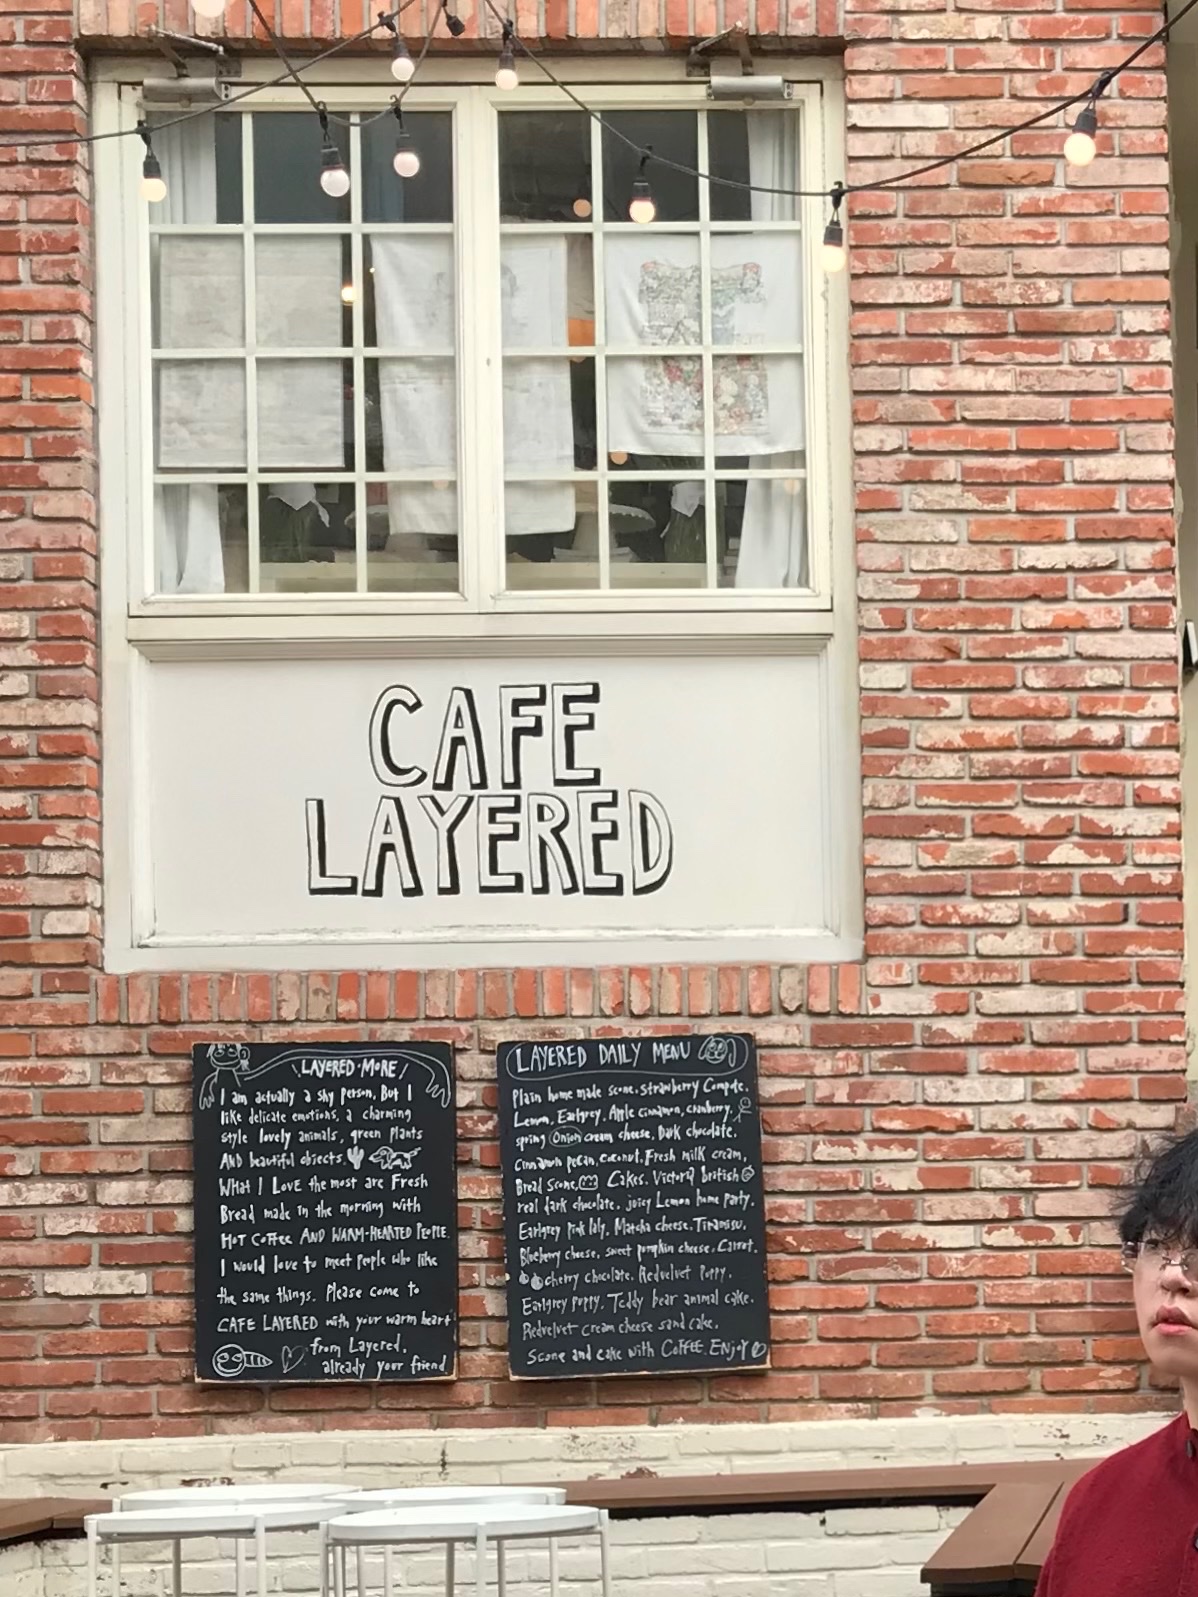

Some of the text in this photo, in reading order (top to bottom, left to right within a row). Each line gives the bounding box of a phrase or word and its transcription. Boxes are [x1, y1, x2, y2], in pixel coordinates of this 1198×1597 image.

[369, 683, 600, 791] CAFE
[305, 789, 673, 898] LAYERED
[516, 1042, 690, 1074] LAYERED DAILY MENU
[221, 1088, 224, 1105] I
[232, 1092, 247, 1105] am
[255, 1088, 295, 1106] actually
[304, 1090, 311, 1102] a
[317, 1089, 334, 1107] shy
[408, 1084, 411, 1101] I
[513, 1089, 542, 1108] Plain
[577, 1084, 601, 1100] made
[249, 1108, 286, 1124] delicate
[292, 1109, 339, 1121] emotions,
[347, 1109, 352, 1122] a
[363, 1106, 411, 1122] charming
[221, 1129, 247, 1149] style
[260, 1128, 291, 1150] lovely
[351, 1130, 381, 1144] green
[516, 1134, 545, 1151] spring
[553, 1131, 581, 1143] Onion
[584, 1133, 613, 1143] cream
[250, 1152, 294, 1169] beautiful
[645, 1148, 675, 1166] Fresh
[258, 1174, 428, 1195] I the most are Fresh
[516, 1177, 542, 1196] Bread
[221, 1196, 420, 1224] Bread made in the morning with
[518, 1198, 538, 1213] real
[544, 1196, 567, 1215] dark
[656, 1191, 690, 1208] Lemon
[332, 1225, 412, 1242] WARM-HEARTED
[615, 1218, 650, 1235] Matcha
[221, 1259, 225, 1276] I
[233, 1255, 265, 1274] would
[274, 1255, 297, 1273] love
[303, 1256, 316, 1273] to
[325, 1253, 352, 1269] meet
[392, 1249, 410, 1265] who
[418, 1251, 437, 1267] like
[545, 1271, 579, 1290] cherry
[217, 1281, 419, 1305] the same things. Please come to
[607, 1290, 643, 1314] Teddy
[653, 1289, 678, 1308] bear
[684, 1289, 718, 1305] animal
[218, 1311, 451, 1332] CAFE LAYERED with your warm heart
[582, 1323, 614, 1336] cream
[619, 1317, 652, 1333] cheese
[658, 1312, 685, 1330] sand
[310, 1333, 406, 1358] from Layered.
[527, 1349, 565, 1364] Scone
[572, 1344, 591, 1361] and
[628, 1341, 654, 1357] with
[322, 1359, 366, 1379] already
[374, 1361, 403, 1381] your
